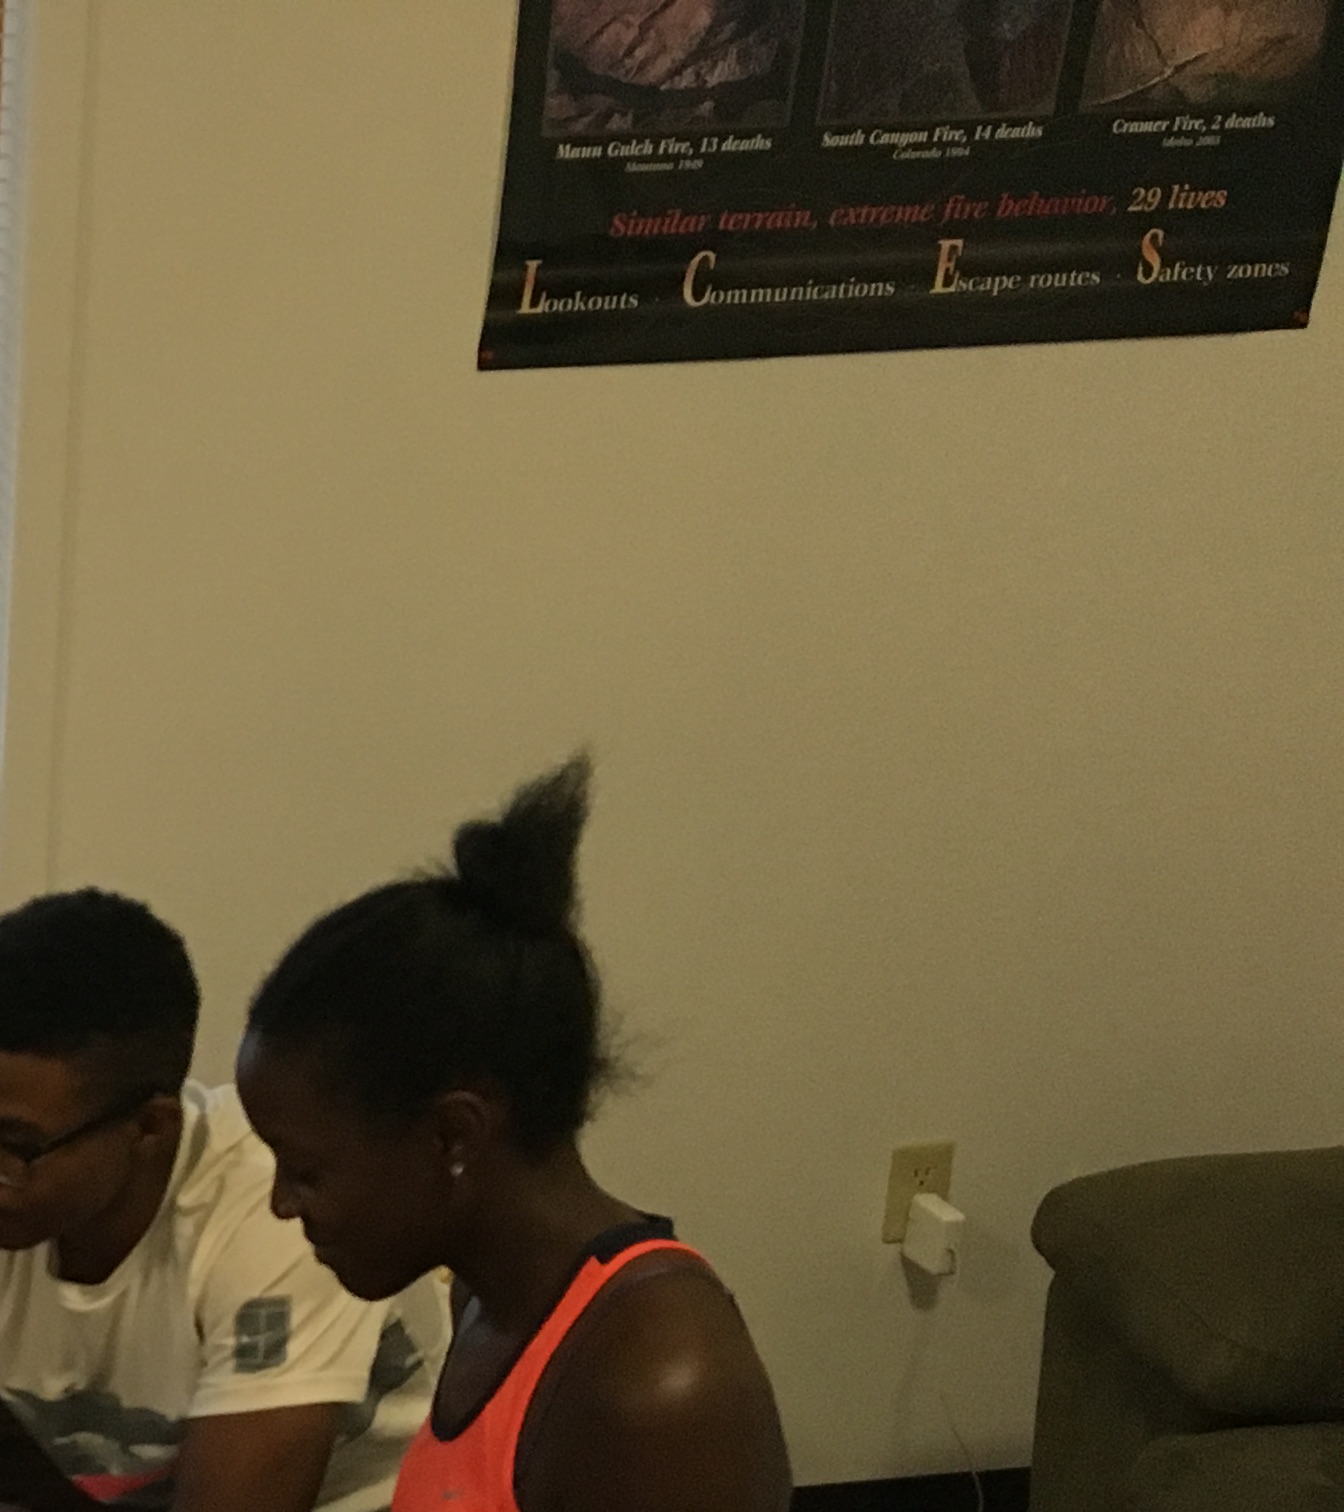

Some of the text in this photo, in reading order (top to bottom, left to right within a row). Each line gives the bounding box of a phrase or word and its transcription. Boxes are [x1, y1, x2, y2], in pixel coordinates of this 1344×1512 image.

[822, 121, 1043, 147] South Canyon Fire, 14 deaths
[1173, 114, 1206, 132] Fire,
[1211, 114, 1222, 130] 2
[1225, 112, 1275, 129] deaths
[607, 138, 653, 158] Gulch
[659, 138, 694, 156] Fire,
[700, 136, 719, 153] 13
[721, 134, 772, 152] deaths
[609, 184, 1228, 237] Similar terrain, extreme fire behavior, 29 lives
[516, 228, 1291, 315] Lookouts Communications Escape routes Safety zones
